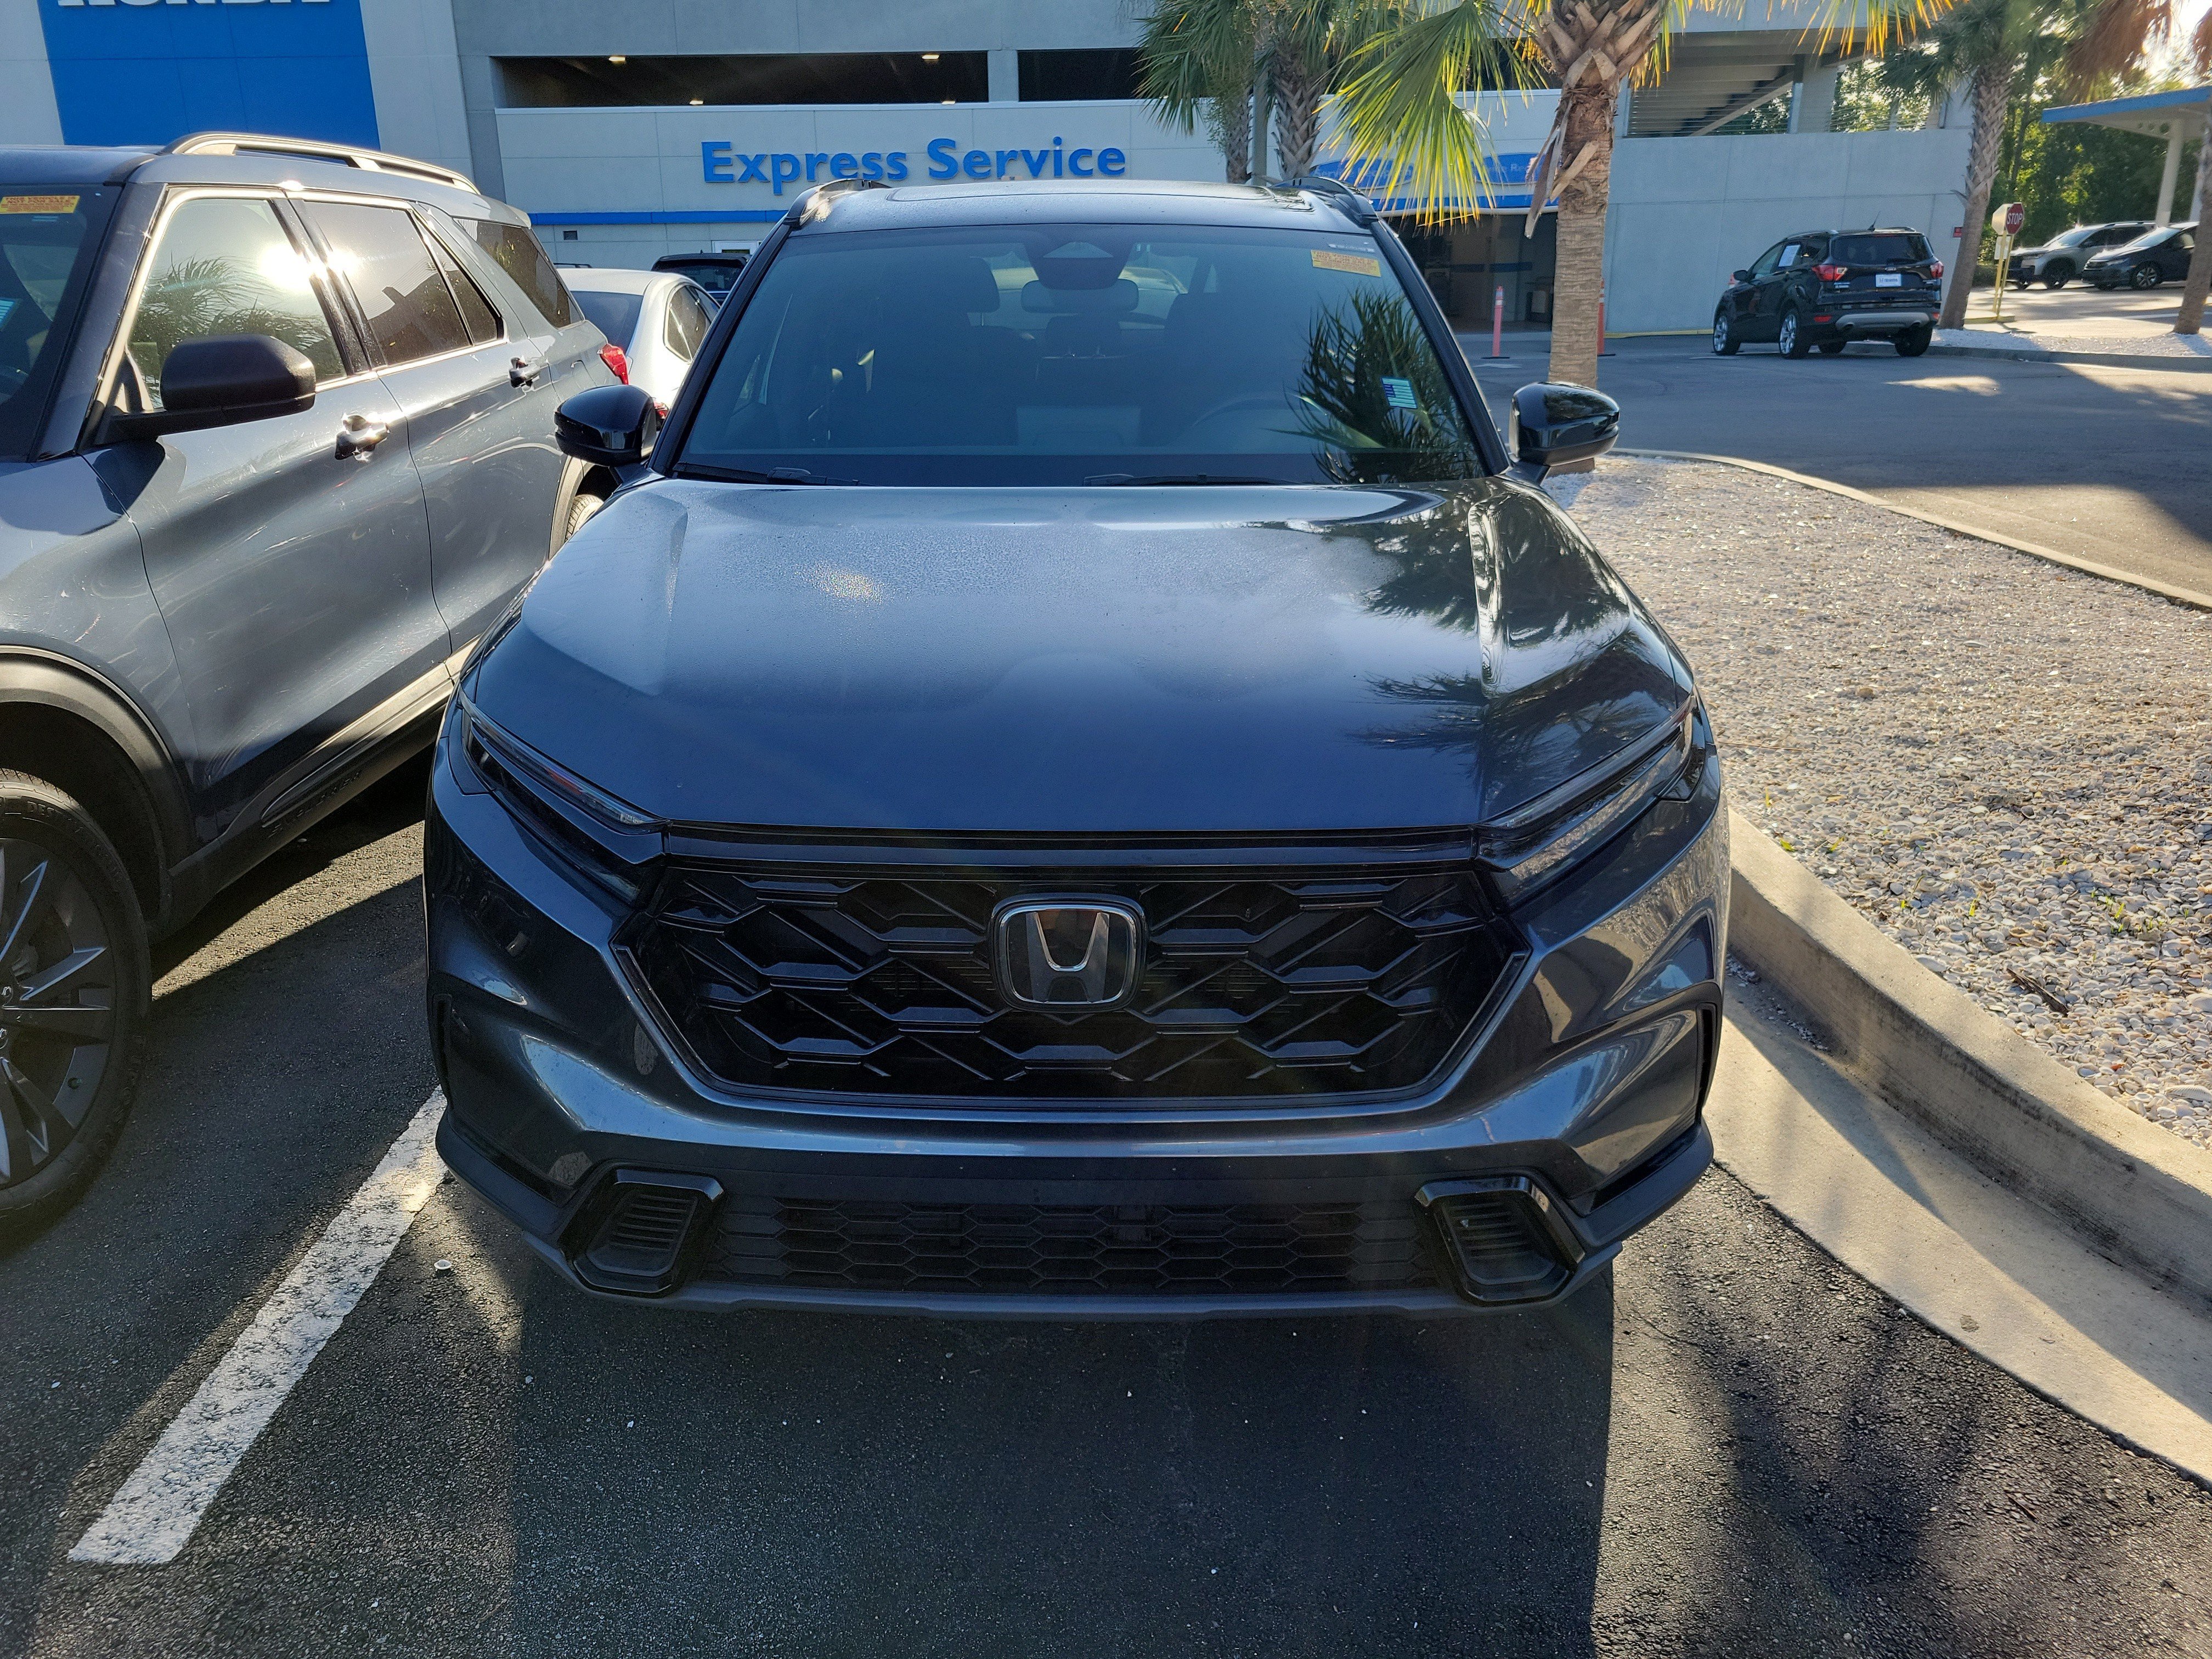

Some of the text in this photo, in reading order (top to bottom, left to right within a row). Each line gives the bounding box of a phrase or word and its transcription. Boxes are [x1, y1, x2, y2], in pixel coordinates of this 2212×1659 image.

[701, 136, 1125, 195] Express Service
[2007, 213, 2023, 224] STOP
